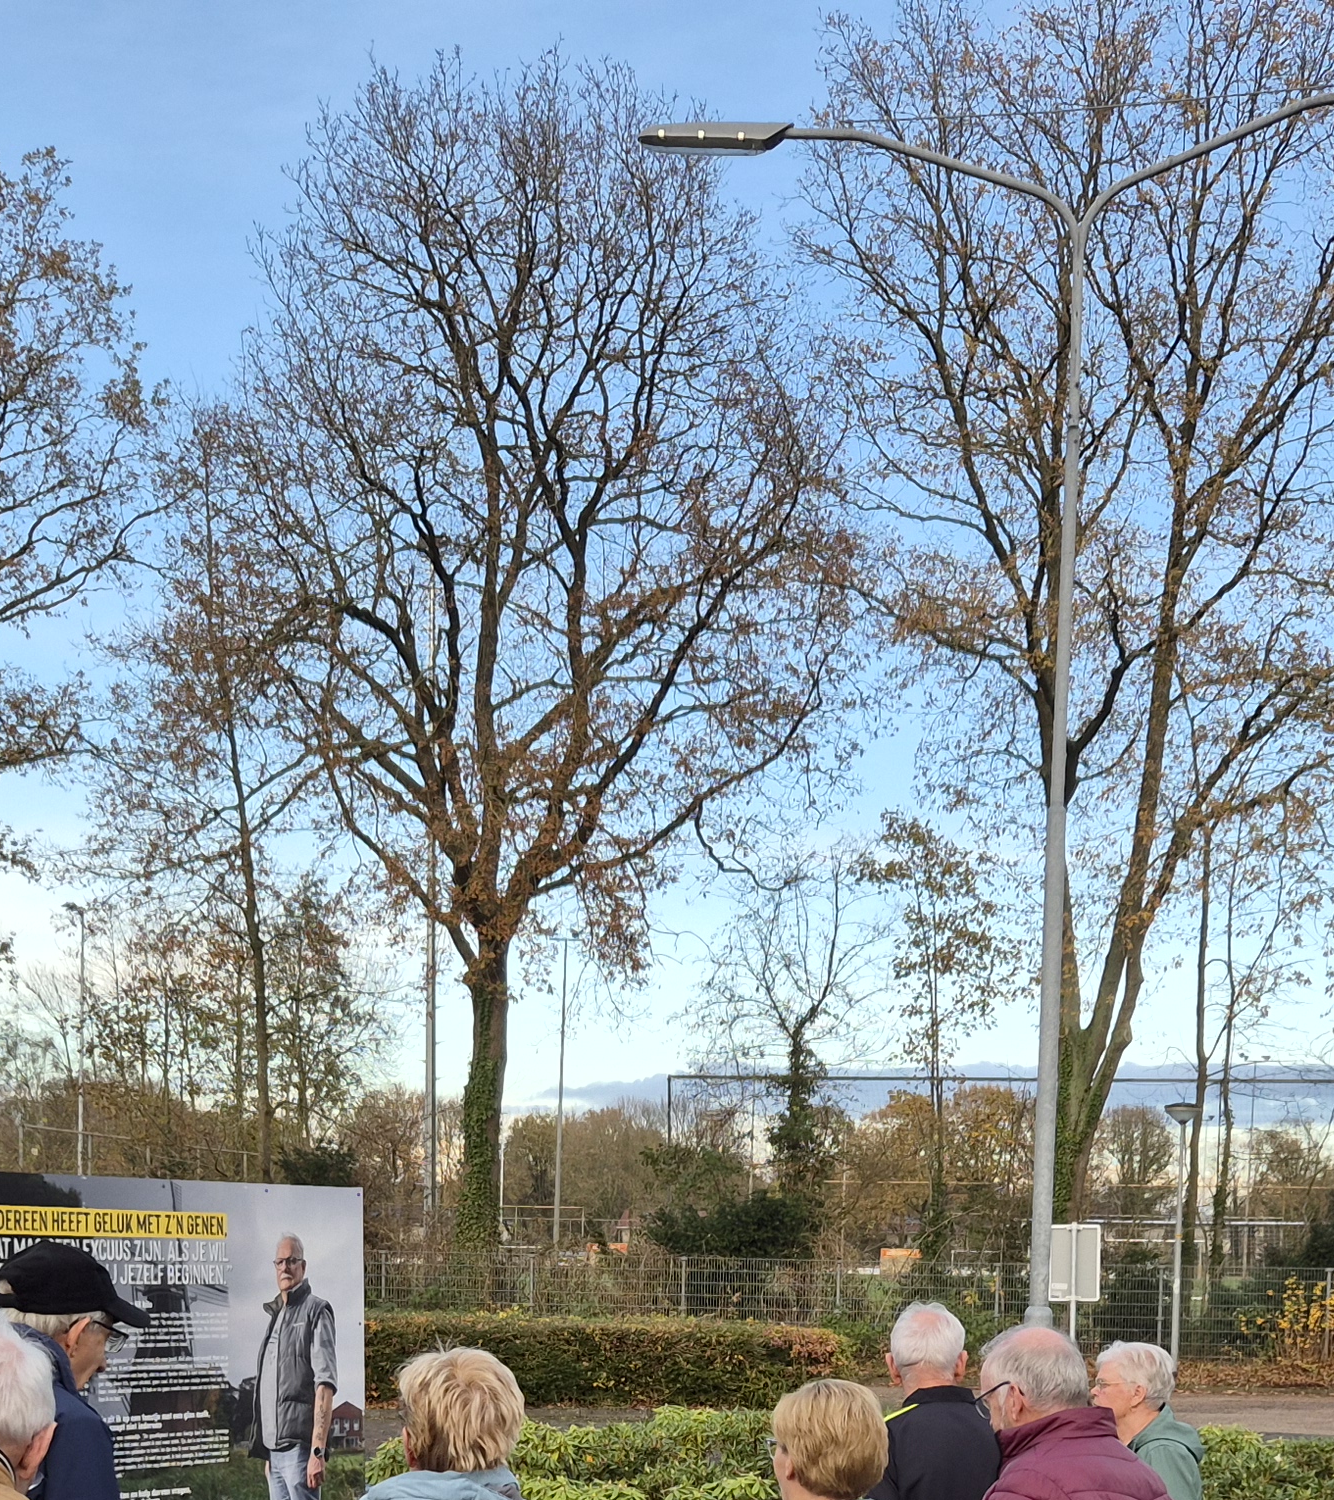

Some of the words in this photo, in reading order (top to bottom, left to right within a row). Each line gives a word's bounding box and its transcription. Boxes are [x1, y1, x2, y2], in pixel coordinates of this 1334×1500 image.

[51, 1211, 90, 1232] HEEFT
[94, 1213, 133, 1233] GELUK
[136, 1214, 161, 1234] MET
[187, 1215, 227, 1238] GENEN,
[82, 1239, 131, 1261] EXCUUS
[134, 1240, 165, 1261] ZIJN.
[168, 1241, 190, 1261] ALS
[192, 1241, 208, 1262] JE
[209, 1242, 228, 1262] WIL
[120, 1264, 164, 1285] JEZELF
